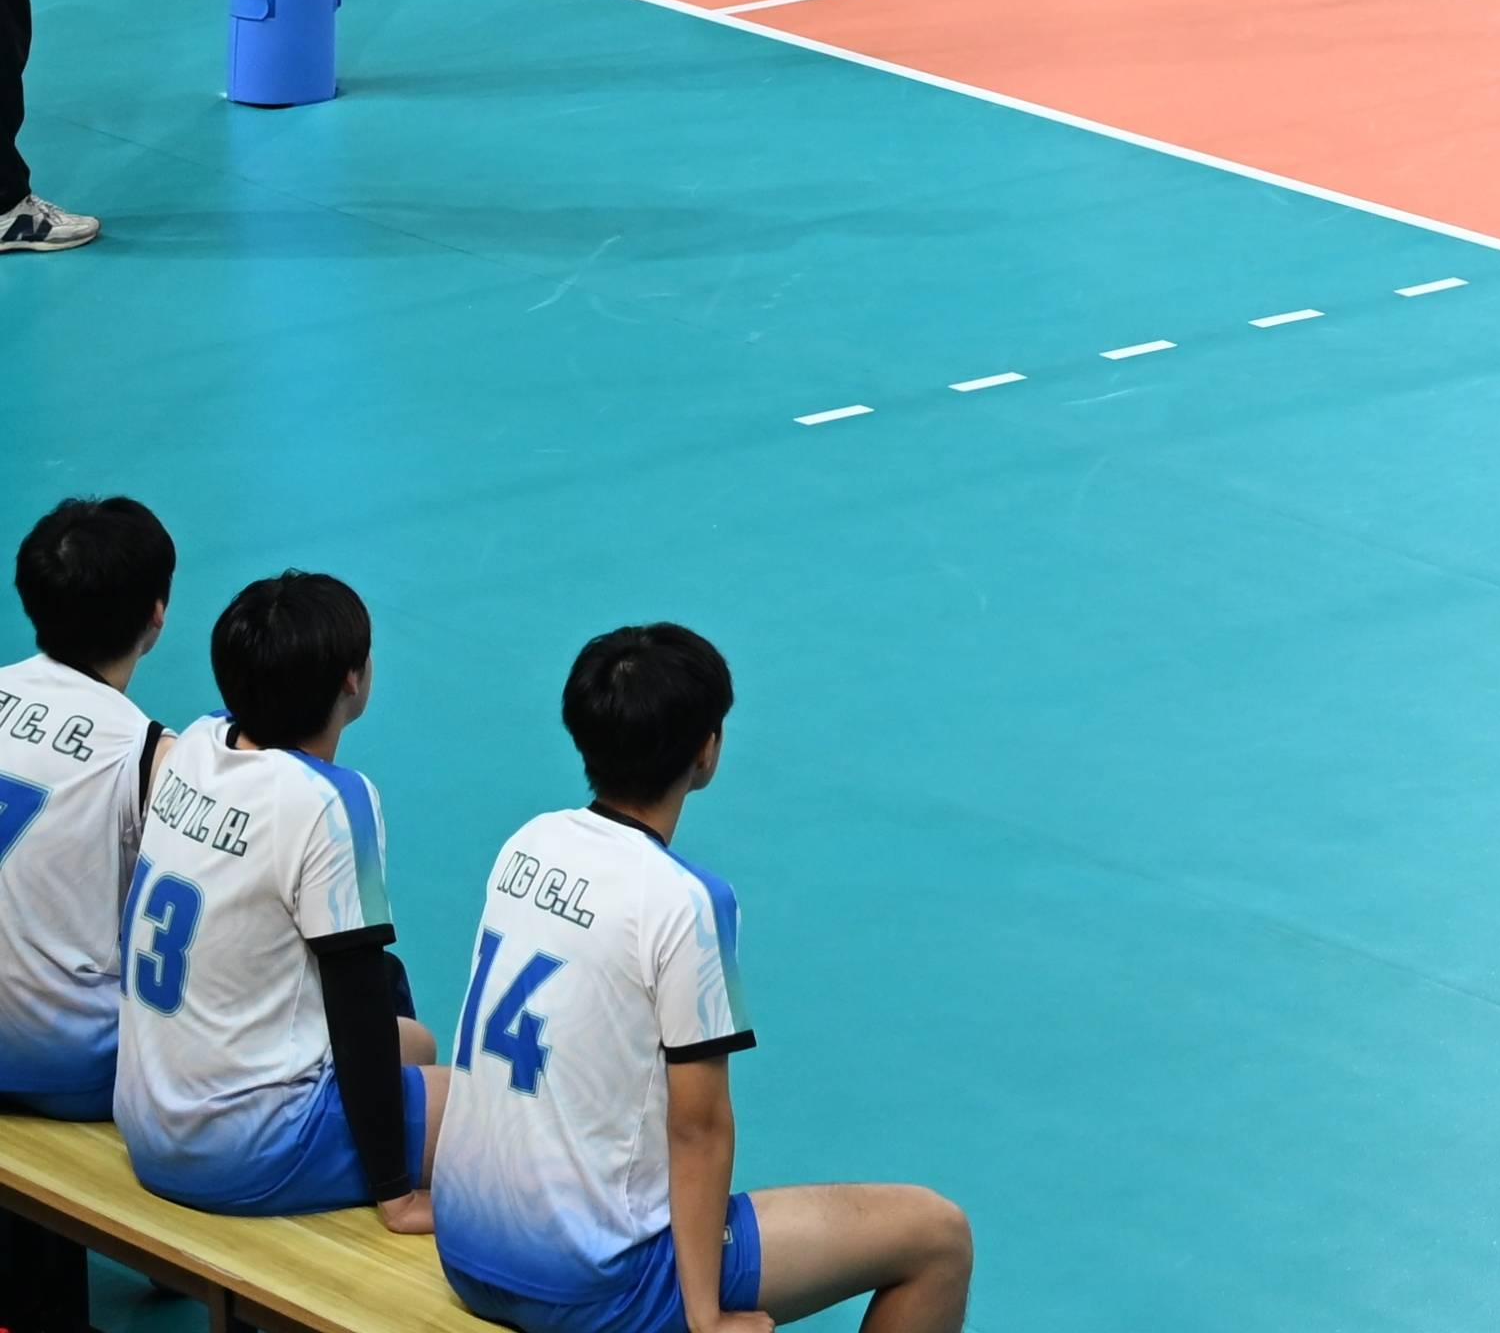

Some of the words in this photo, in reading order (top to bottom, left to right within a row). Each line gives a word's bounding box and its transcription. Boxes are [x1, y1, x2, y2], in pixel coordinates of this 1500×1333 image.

[10, 703, 48, 744] C.
[53, 715, 94, 762] C.
[212, 807, 250, 857] H.
[497, 852, 540, 899] NG
[118, 853, 205, 1017] 13
[456, 926, 568, 1098] 14
